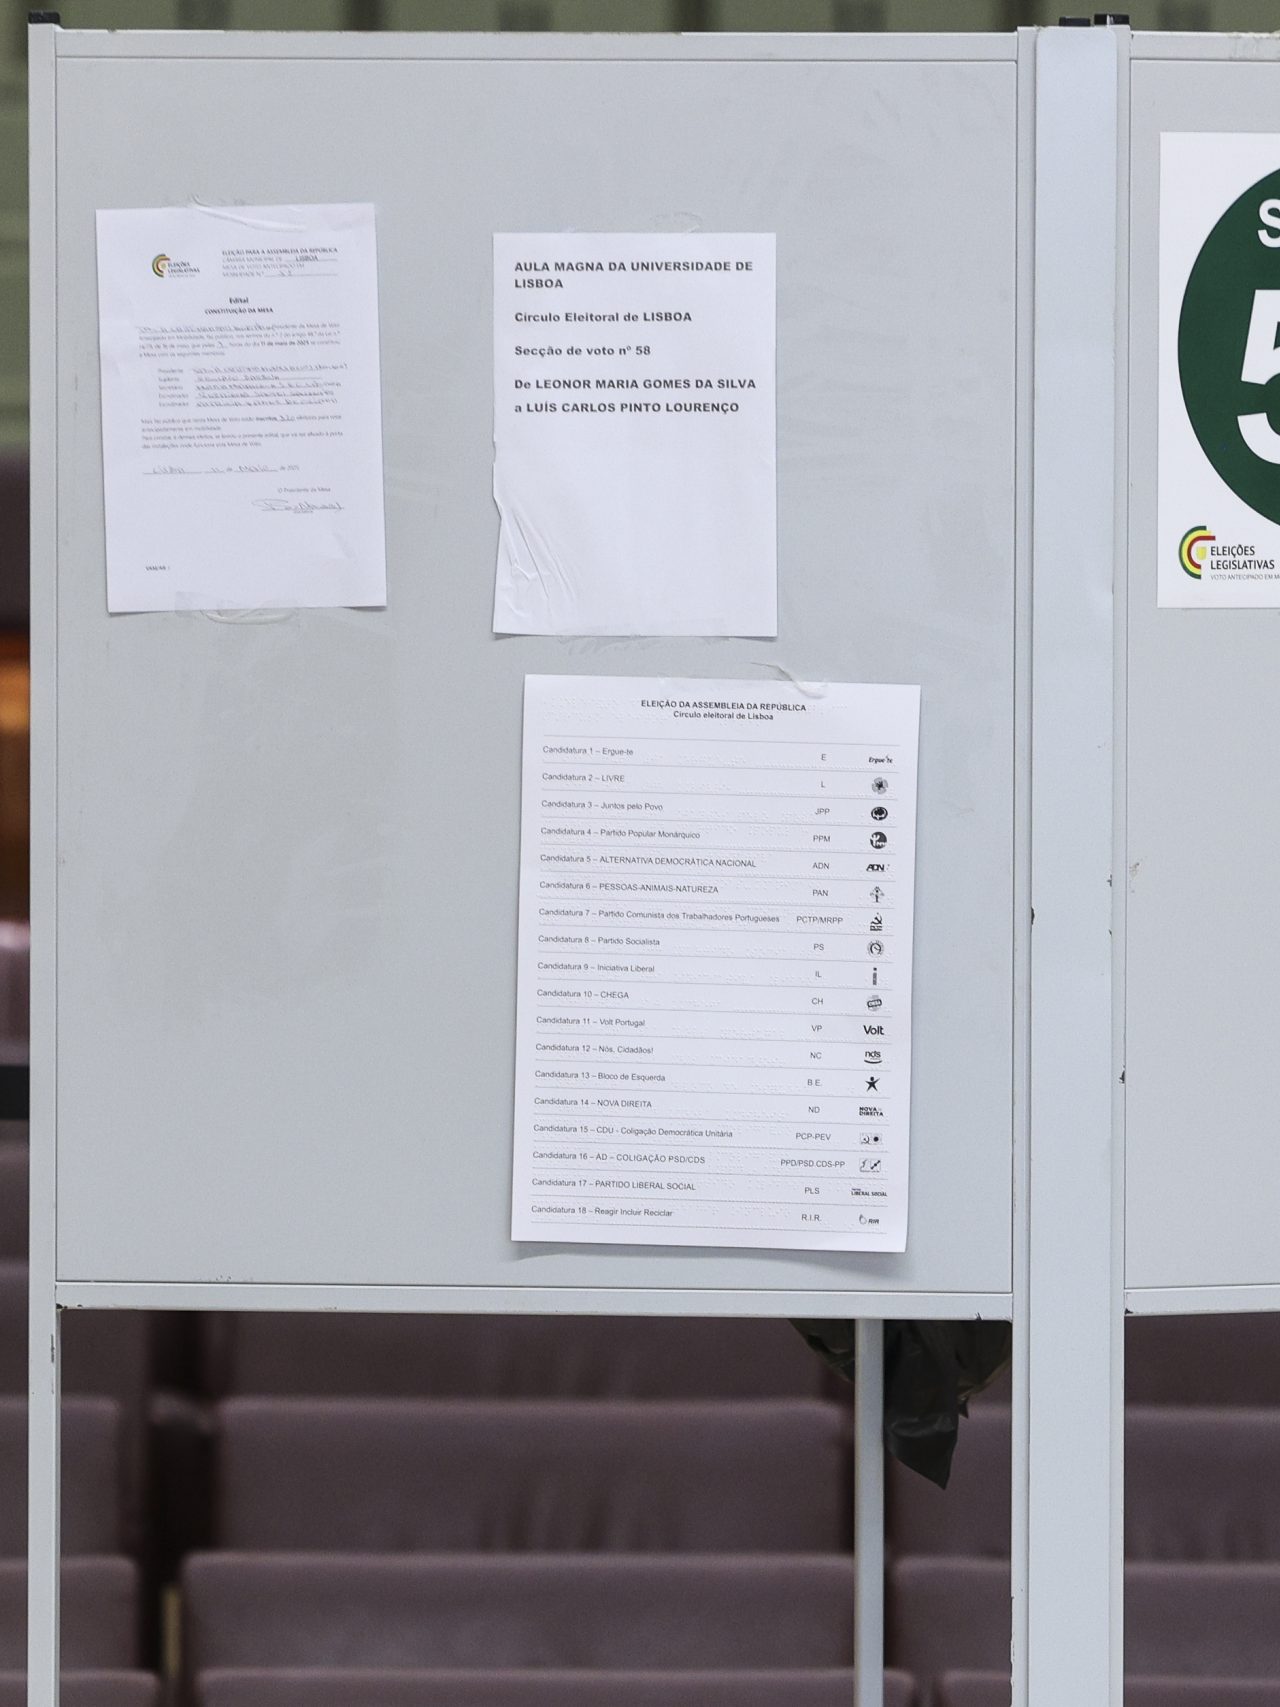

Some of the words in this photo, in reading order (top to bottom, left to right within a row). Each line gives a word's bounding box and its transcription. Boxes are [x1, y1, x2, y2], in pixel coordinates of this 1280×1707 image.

[514, 262, 549, 271] AULA
[554, 262, 604, 271] MAGNA
[608, 262, 626, 271] DA
[631, 261, 730, 271] UNIVERSIDADE
[735, 261, 752, 270] DE
[515, 278, 563, 288] LISBOA
[565, 312, 618, 321] Eleitoral
[623, 312, 638, 321] de
[643, 312, 691, 321] LISBOA
[515, 345, 562, 357] Secção
[566, 346, 582, 355] de
[586, 346, 614, 355] voto
[619, 345, 631, 355] nº
[635, 345, 650, 355] 58
[515, 379, 530, 388] De
[536, 379, 591, 388] LEONOR
[595, 379, 638, 388] MARIA
[643, 379, 690, 388] GOMES
[695, 379, 713, 388] DA
[717, 378, 755, 388] SILVA
[526, 401, 557, 412] LUÍS
[561, 402, 615, 412] CARLOS
[620, 402, 660, 412] PINTO
[666, 402, 738, 414] LOURENÇO
[1210, 544, 1255, 558] ELEIÇÕES
[1210, 559, 1274, 569] LEGISLATIVAS
[641, 699, 677, 709] ELEIÇÃO
[760, 703, 806, 711] REPÚBLICA
[542, 745, 586, 754] Candidatura
[602, 747, 633, 756] Ergue-te
[542, 772, 586, 781] Candidatura
[601, 774, 624, 782] LIVRE
[541, 799, 585, 808] Candidatura
[626, 802, 642, 810] pelo
[644, 802, 663, 810] Povo
[540, 824, 585, 835] Candidatura
[600, 828, 626, 837] Partido
[628, 829, 656, 838] Popular
[658, 830, 700, 839] Monárquico
[540, 854, 584, 862] Candidatura
[599, 855, 653, 864] ALTERNATIVA
[654, 857, 714, 866] DEMOCRÁTICA
[715, 859, 756, 867] NACIONAL
[539, 881, 583, 889] Candidatura
[599, 882, 718, 893] PESSOAS-ANIMAIS-NATUREZA
[538, 908, 583, 917] Candidatura
[626, 910, 664, 918] Comunista
[681, 911, 733, 920] Trabalhadores
[734, 913, 779, 923] Portugueses
[796, 915, 843, 924] PCTP/MRPP
[538, 934, 582, 943] Candidatura
[625, 937, 660, 945] Socialista
[537, 962, 581, 970] Candidatura
[536, 989, 581, 997] Candidatura
[600, 990, 629, 999] CHEGA
[536, 1016, 580, 1024] Candidatura
[615, 1019, 645, 1028] Portugal
[863, 1024, 884, 1035] Volt
[535, 1043, 579, 1051] Candidatura
[617, 1045, 653, 1054] Cidadãos!
[534, 1070, 578, 1078] Candidatura
[631, 1073, 665, 1082] Esquerda
[534, 1097, 578, 1105] Candidatura
[533, 1124, 577, 1132] Candidatura
[596, 1126, 613, 1136] CDU
[620, 1126, 656, 1136] Coligação
[658, 1128, 703, 1136] Democrática
[795, 1132, 831, 1140] PCP-PEV
[532, 1150, 576, 1159] Candidatura
[616, 1153, 666, 1163] COLIGAÇÃO
[668, 1155, 705, 1164] PSD/CDS
[532, 1178, 576, 1186] Candidatura
[595, 1180, 630, 1188] PARTIDO
[632, 1181, 664, 1189] LIBERAL
[666, 1182, 696, 1190] SOCIAL
[531, 1205, 575, 1213] Candidatura
[594, 1206, 618, 1216] Reagir
